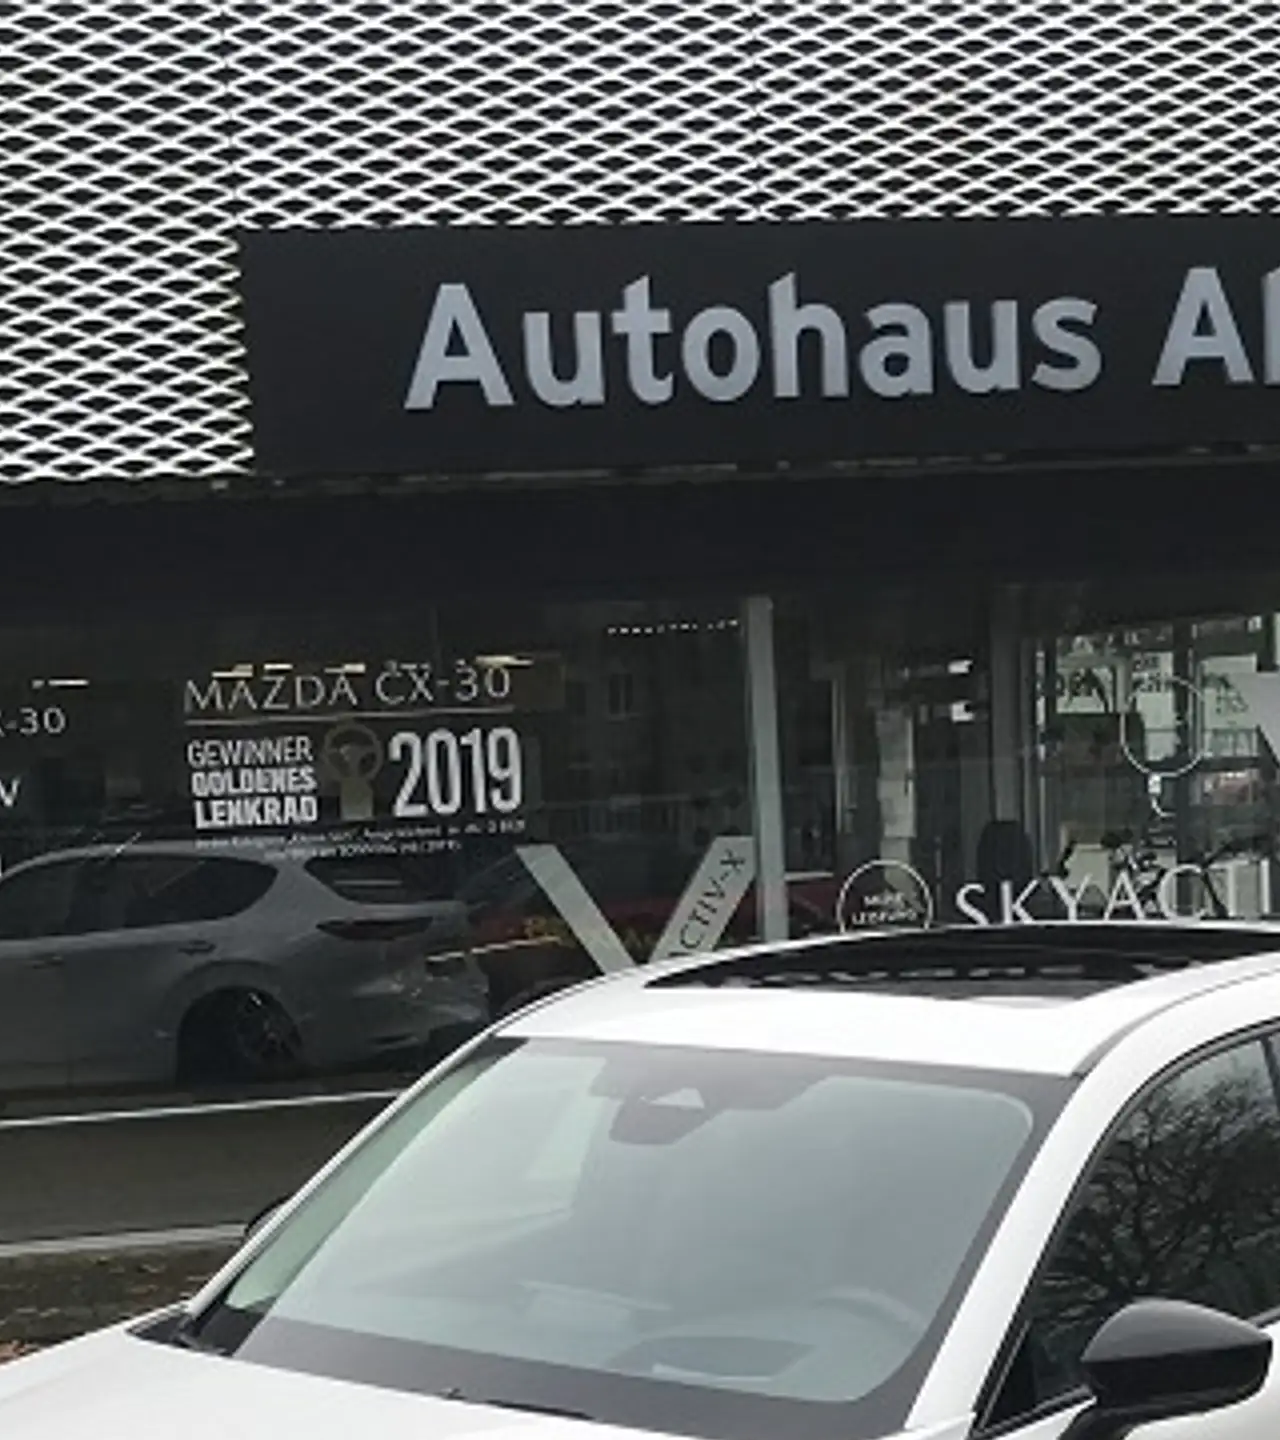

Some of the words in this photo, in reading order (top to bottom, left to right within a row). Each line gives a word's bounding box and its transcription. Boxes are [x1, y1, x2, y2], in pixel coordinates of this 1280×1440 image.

[403, 270, 1102, 410] Autohaus
[184, 673, 358, 713] MAZDA
[375, 660, 511, 705] CX-30
[187, 735, 314, 769] GEWINNER
[388, 727, 523, 819] 2019
[191, 765, 317, 797] GOLDENES
[194, 796, 318, 829] LENKRAD
[668, 848, 746, 957] CTIV-X
